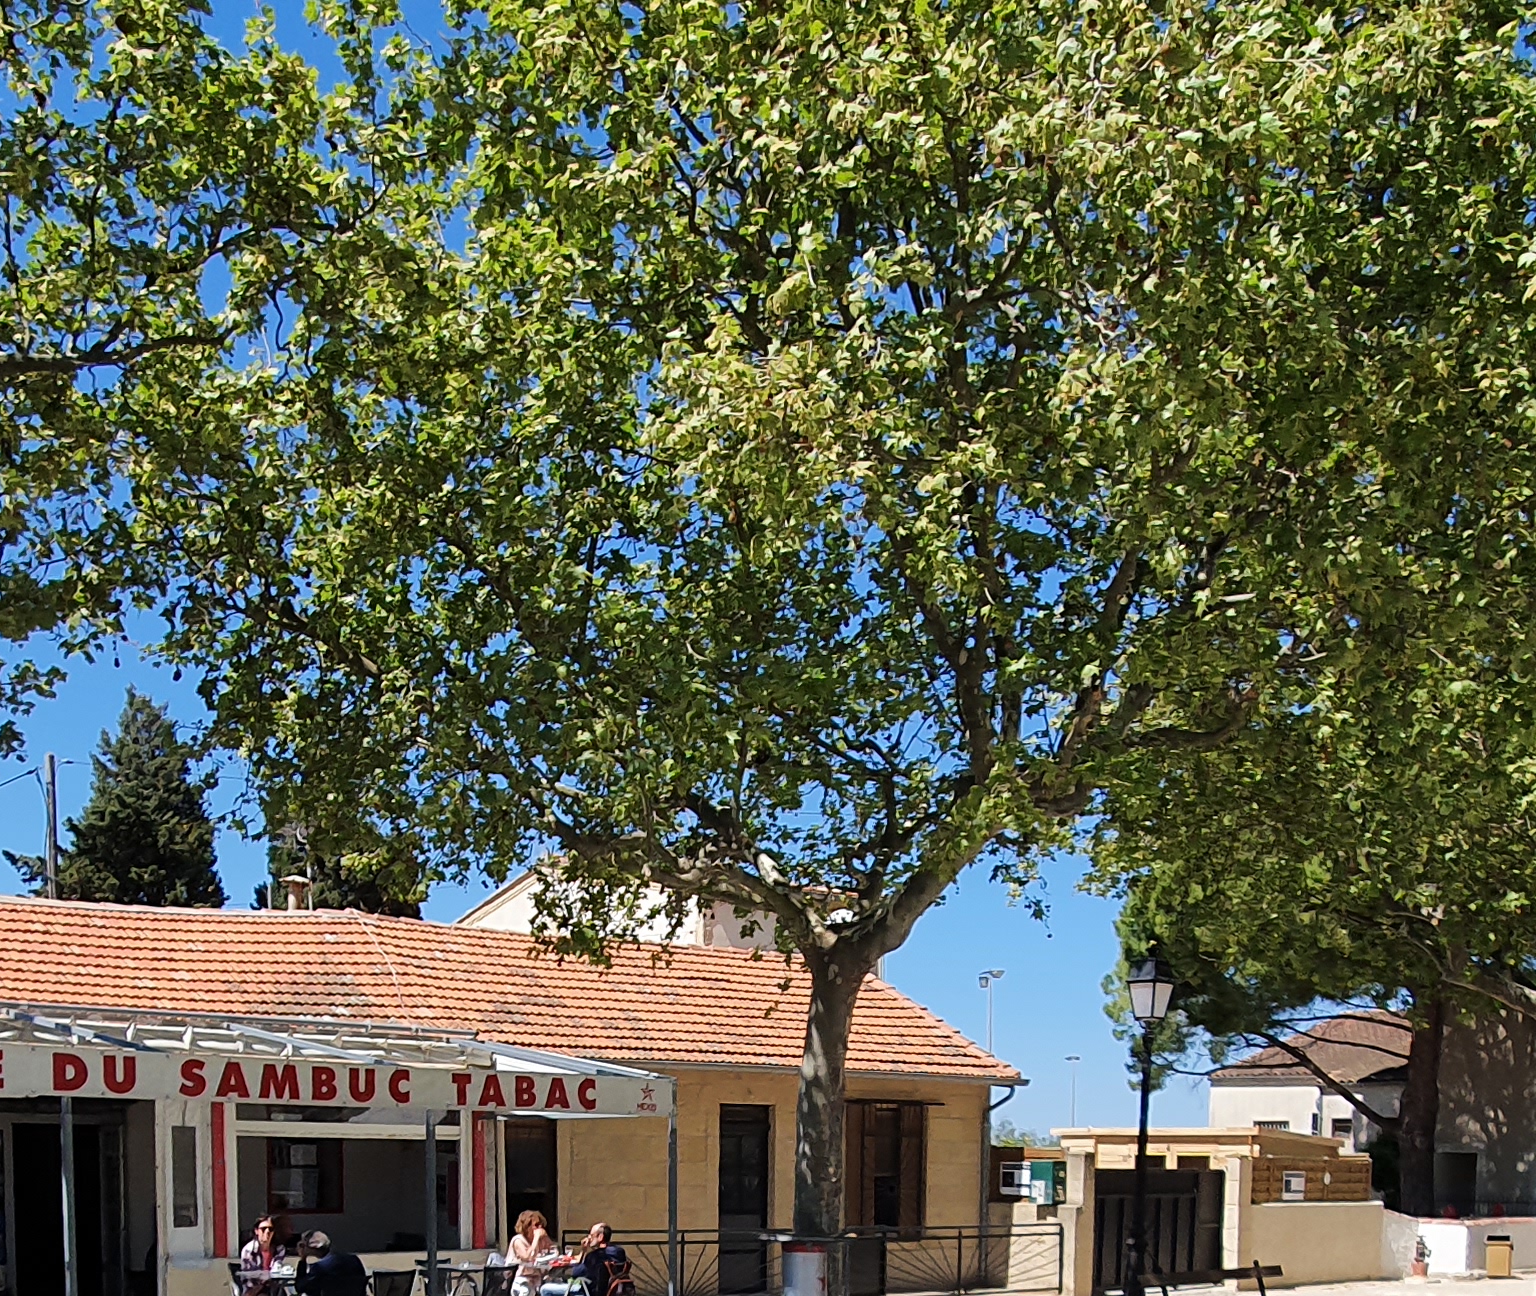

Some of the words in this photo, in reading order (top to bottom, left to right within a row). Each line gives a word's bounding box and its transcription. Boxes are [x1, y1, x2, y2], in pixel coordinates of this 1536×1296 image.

[52, 1053, 137, 1095] DU
[179, 1059, 412, 1104] SAMBUC
[451, 1072, 599, 1111] TABAC
